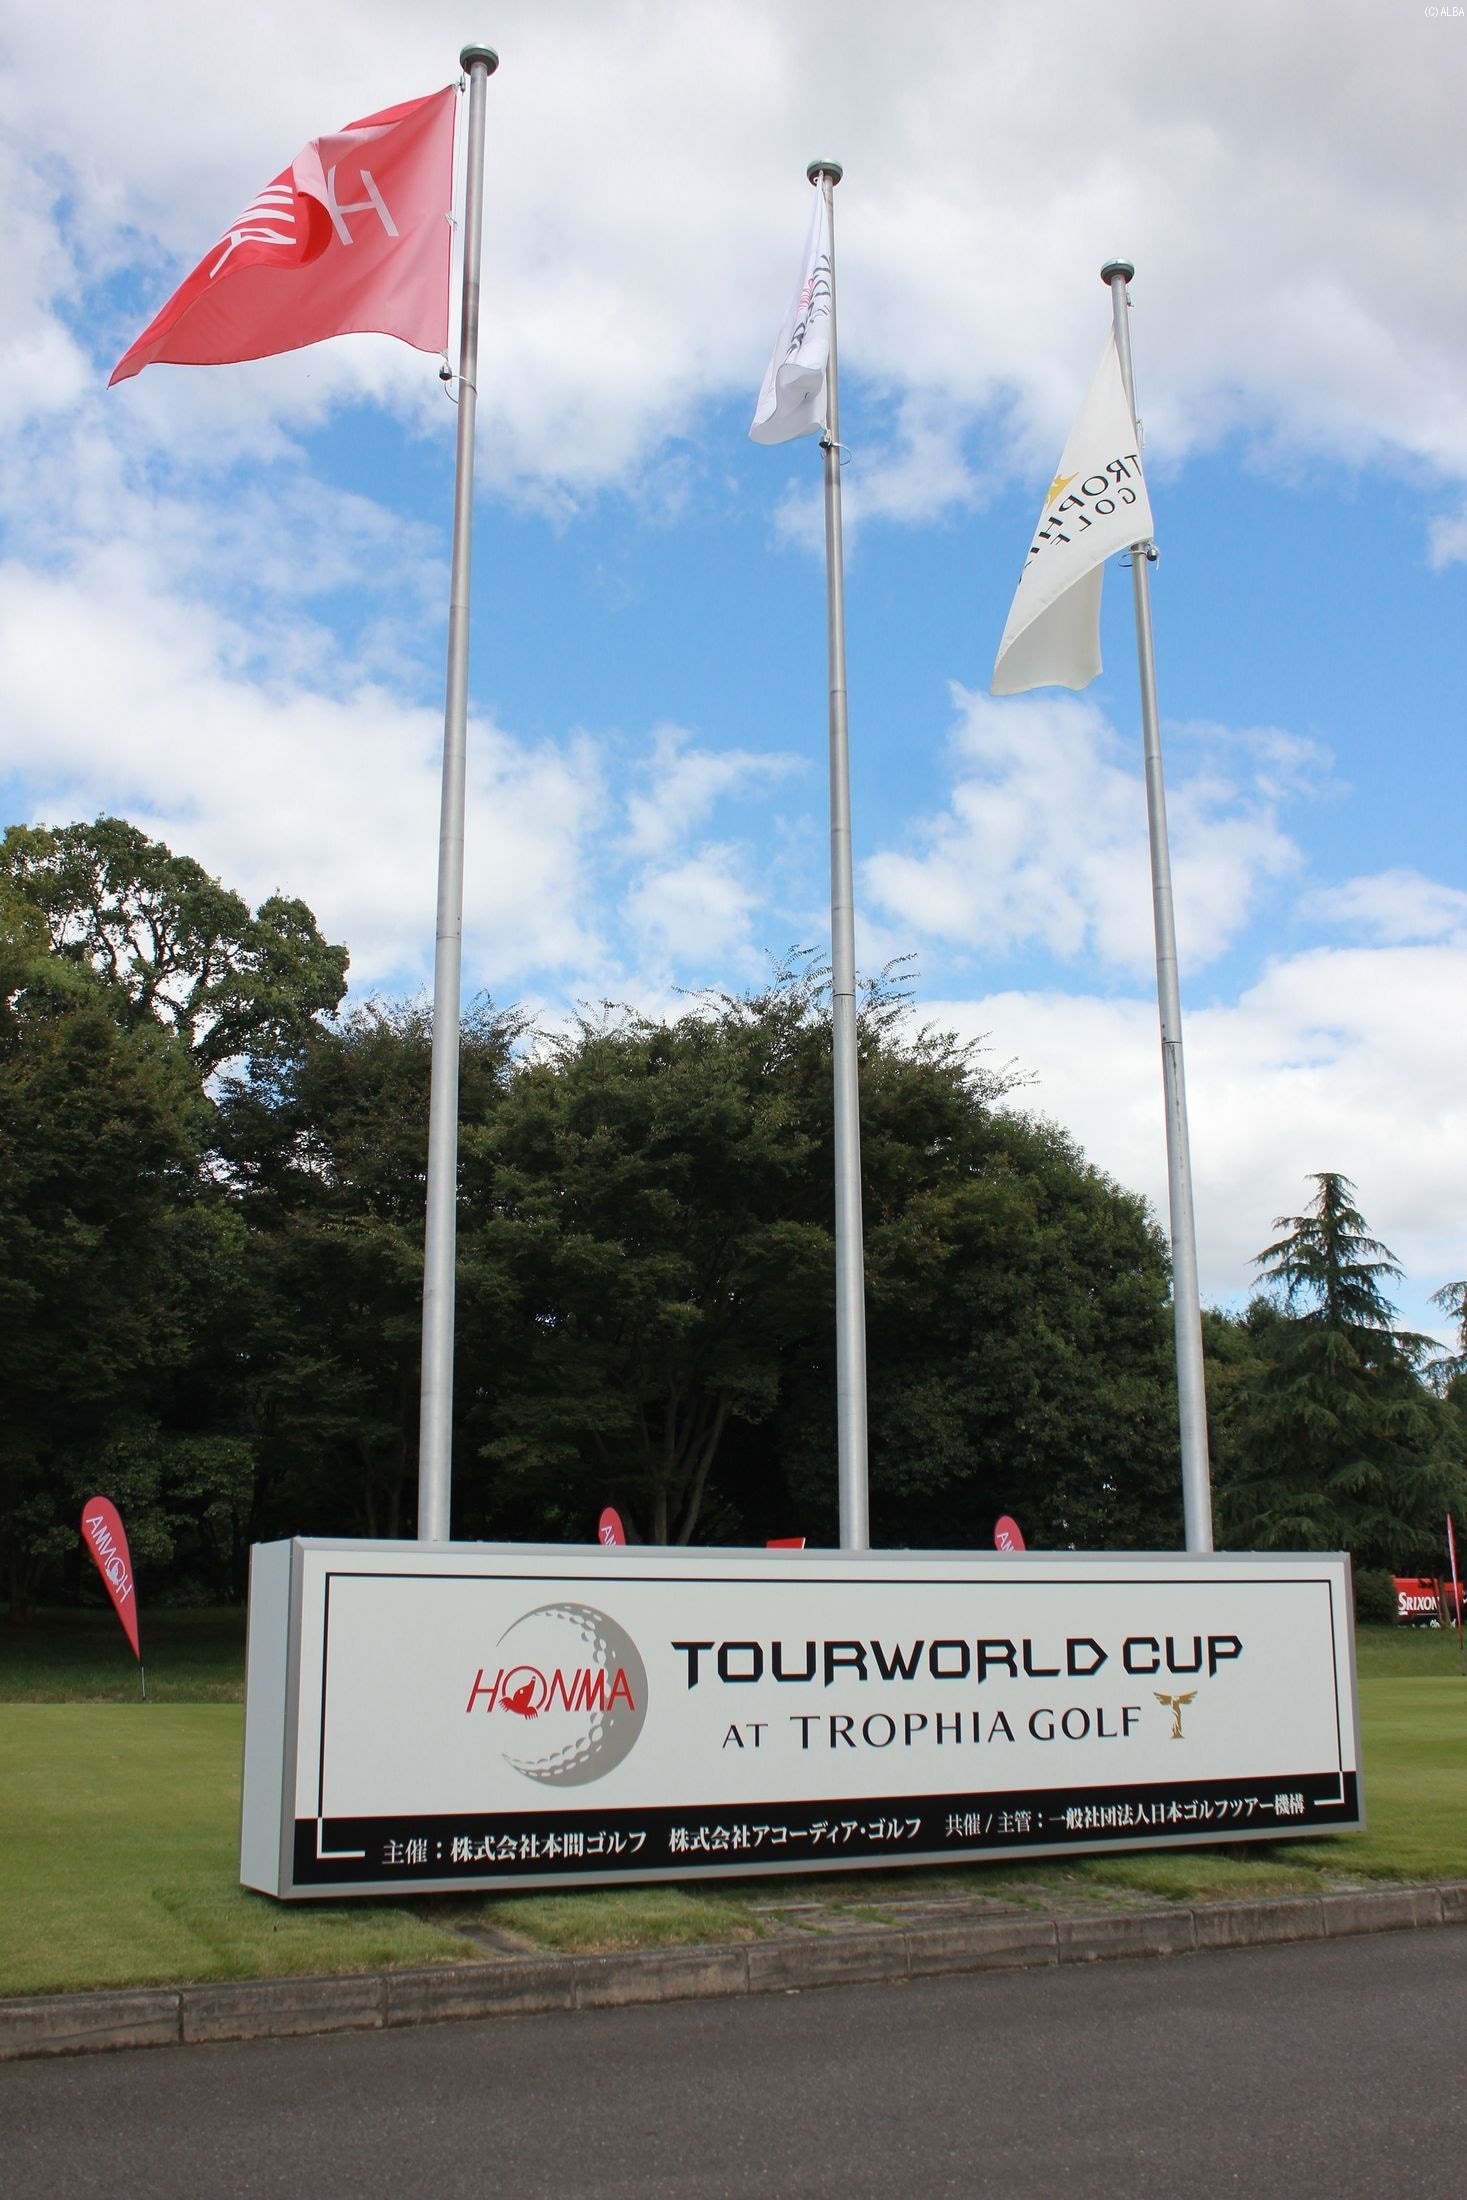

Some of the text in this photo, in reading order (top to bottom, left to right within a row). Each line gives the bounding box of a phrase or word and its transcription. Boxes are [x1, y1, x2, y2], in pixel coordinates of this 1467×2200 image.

[671, 1635, 1243, 1690] TOURWORLD CUP
[466, 1665, 636, 1720] HONMA
[722, 1706, 1141, 1750] AT TROPHIA GOLF
